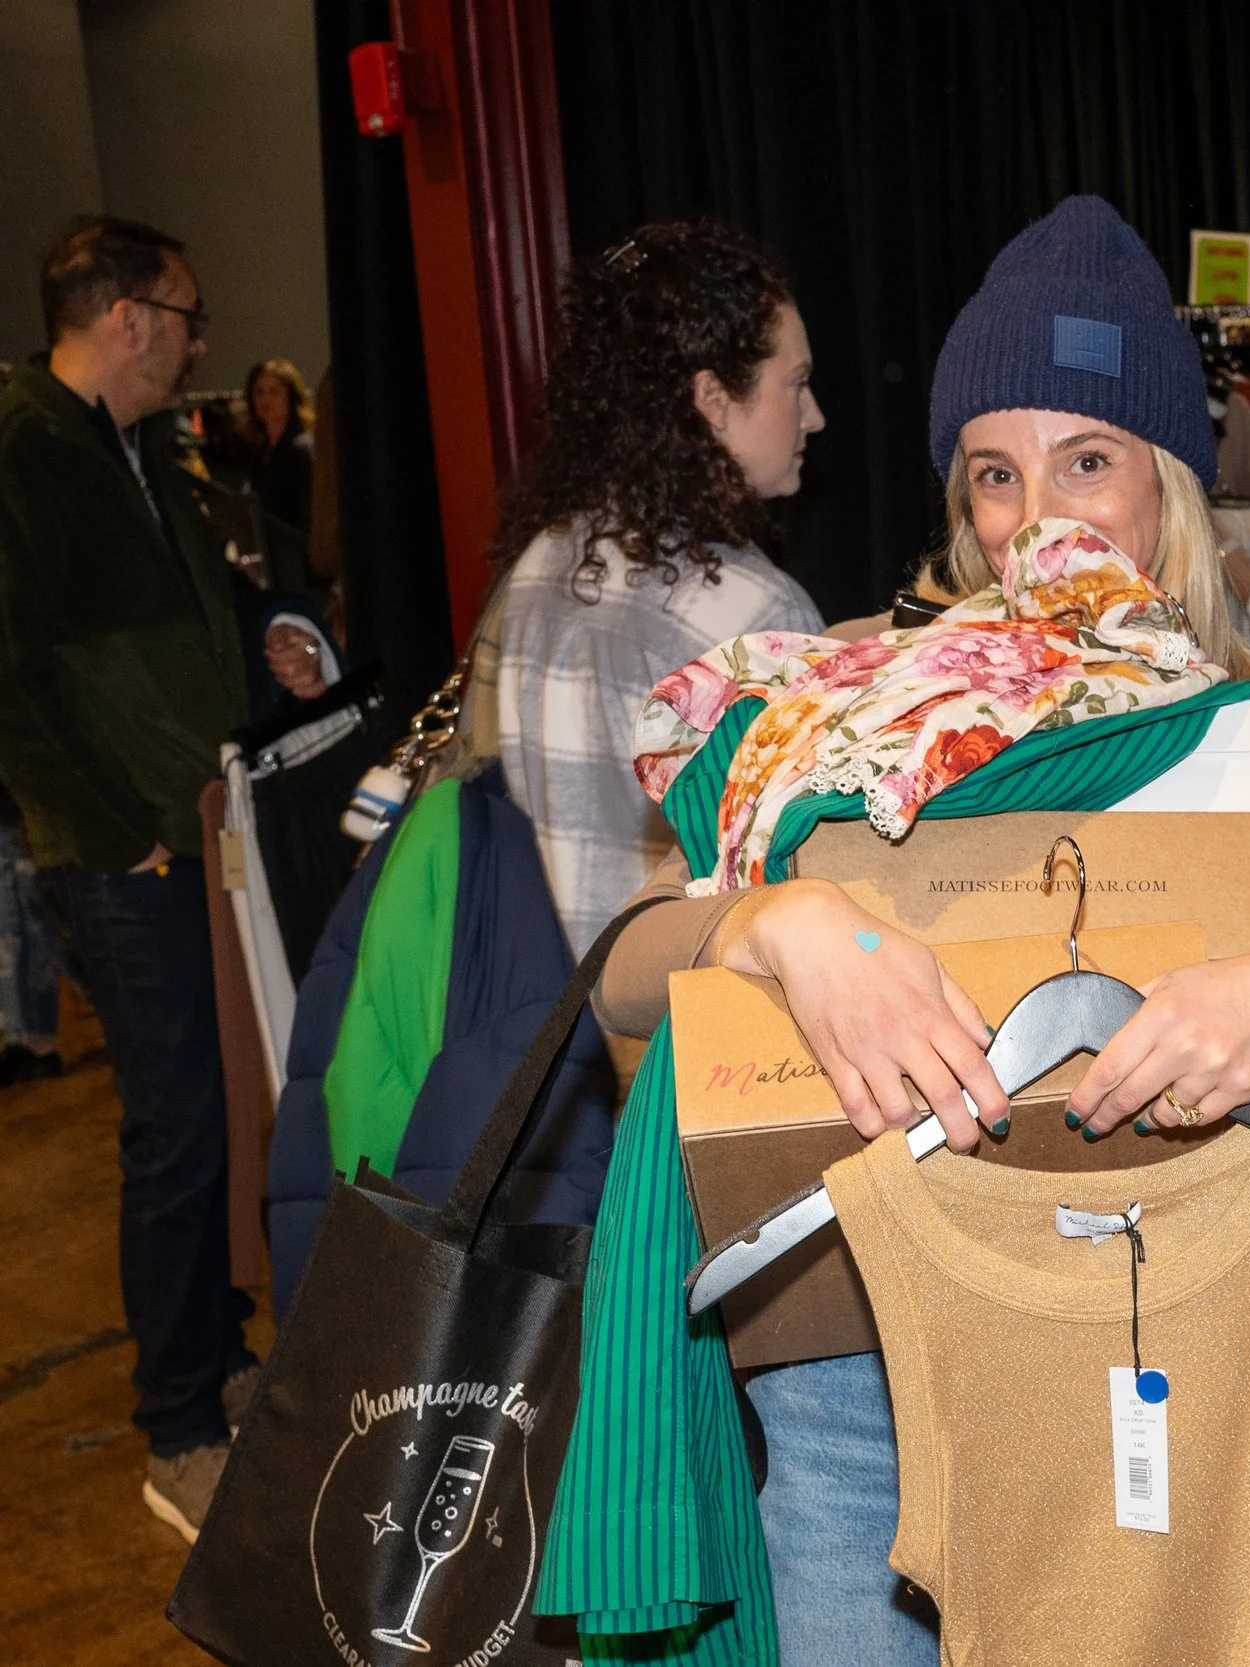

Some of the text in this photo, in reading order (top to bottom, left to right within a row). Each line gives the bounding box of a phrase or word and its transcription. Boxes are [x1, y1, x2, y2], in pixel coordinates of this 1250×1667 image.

[928, 880, 1168, 893] MATISSEFOOTWEAR.COM
[704, 1057, 828, 1096] Matis
[351, 1381, 498, 1436] Champagne
[454, 1619, 515, 1667] UDGET
